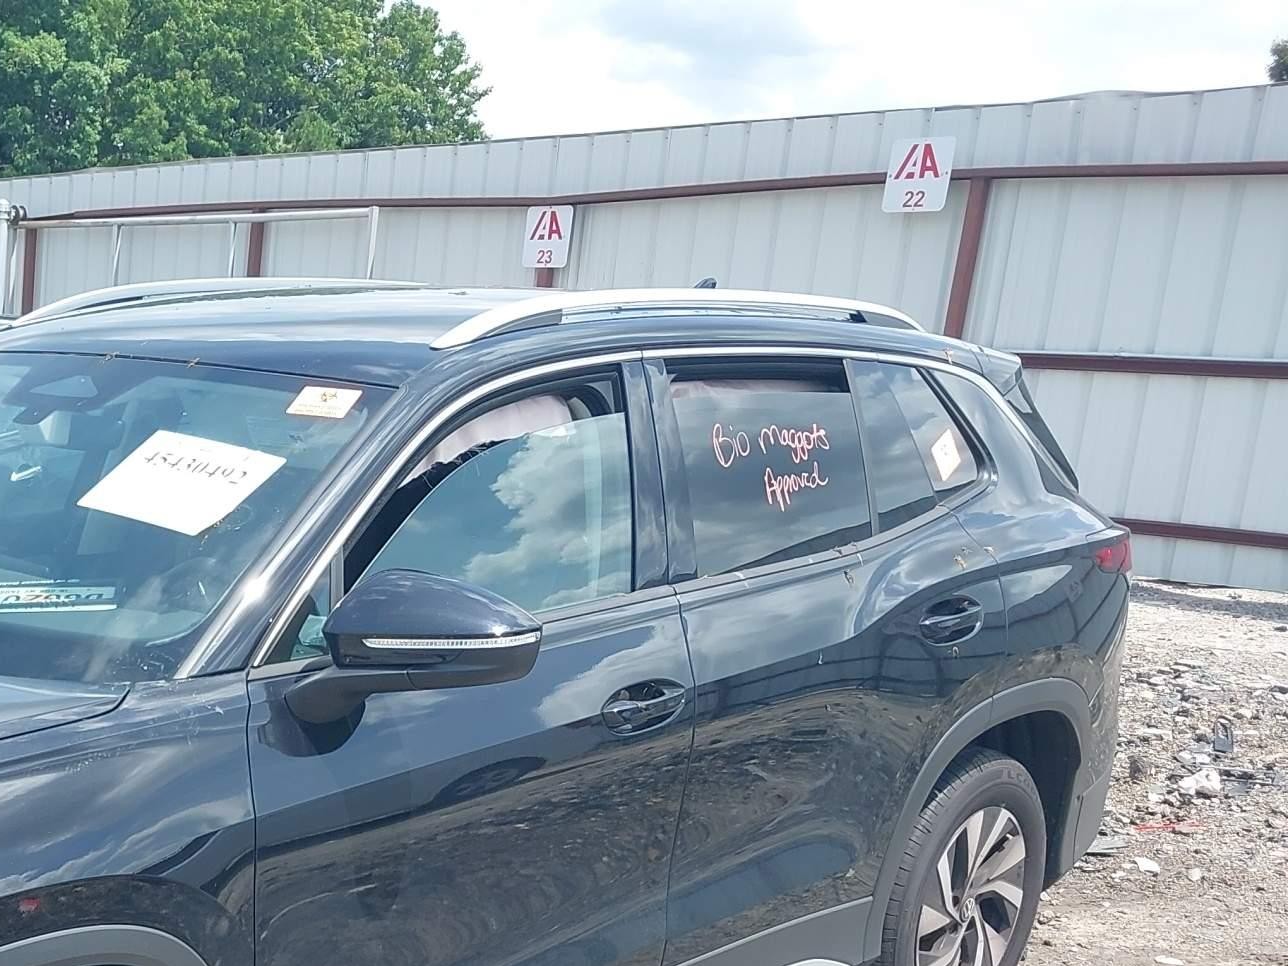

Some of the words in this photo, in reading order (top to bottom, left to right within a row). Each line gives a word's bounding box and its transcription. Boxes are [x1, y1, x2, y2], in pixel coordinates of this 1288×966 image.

[902, 190, 926, 209] 22
[536, 249, 553, 264] 23
[713, 423, 750, 467] Bio
